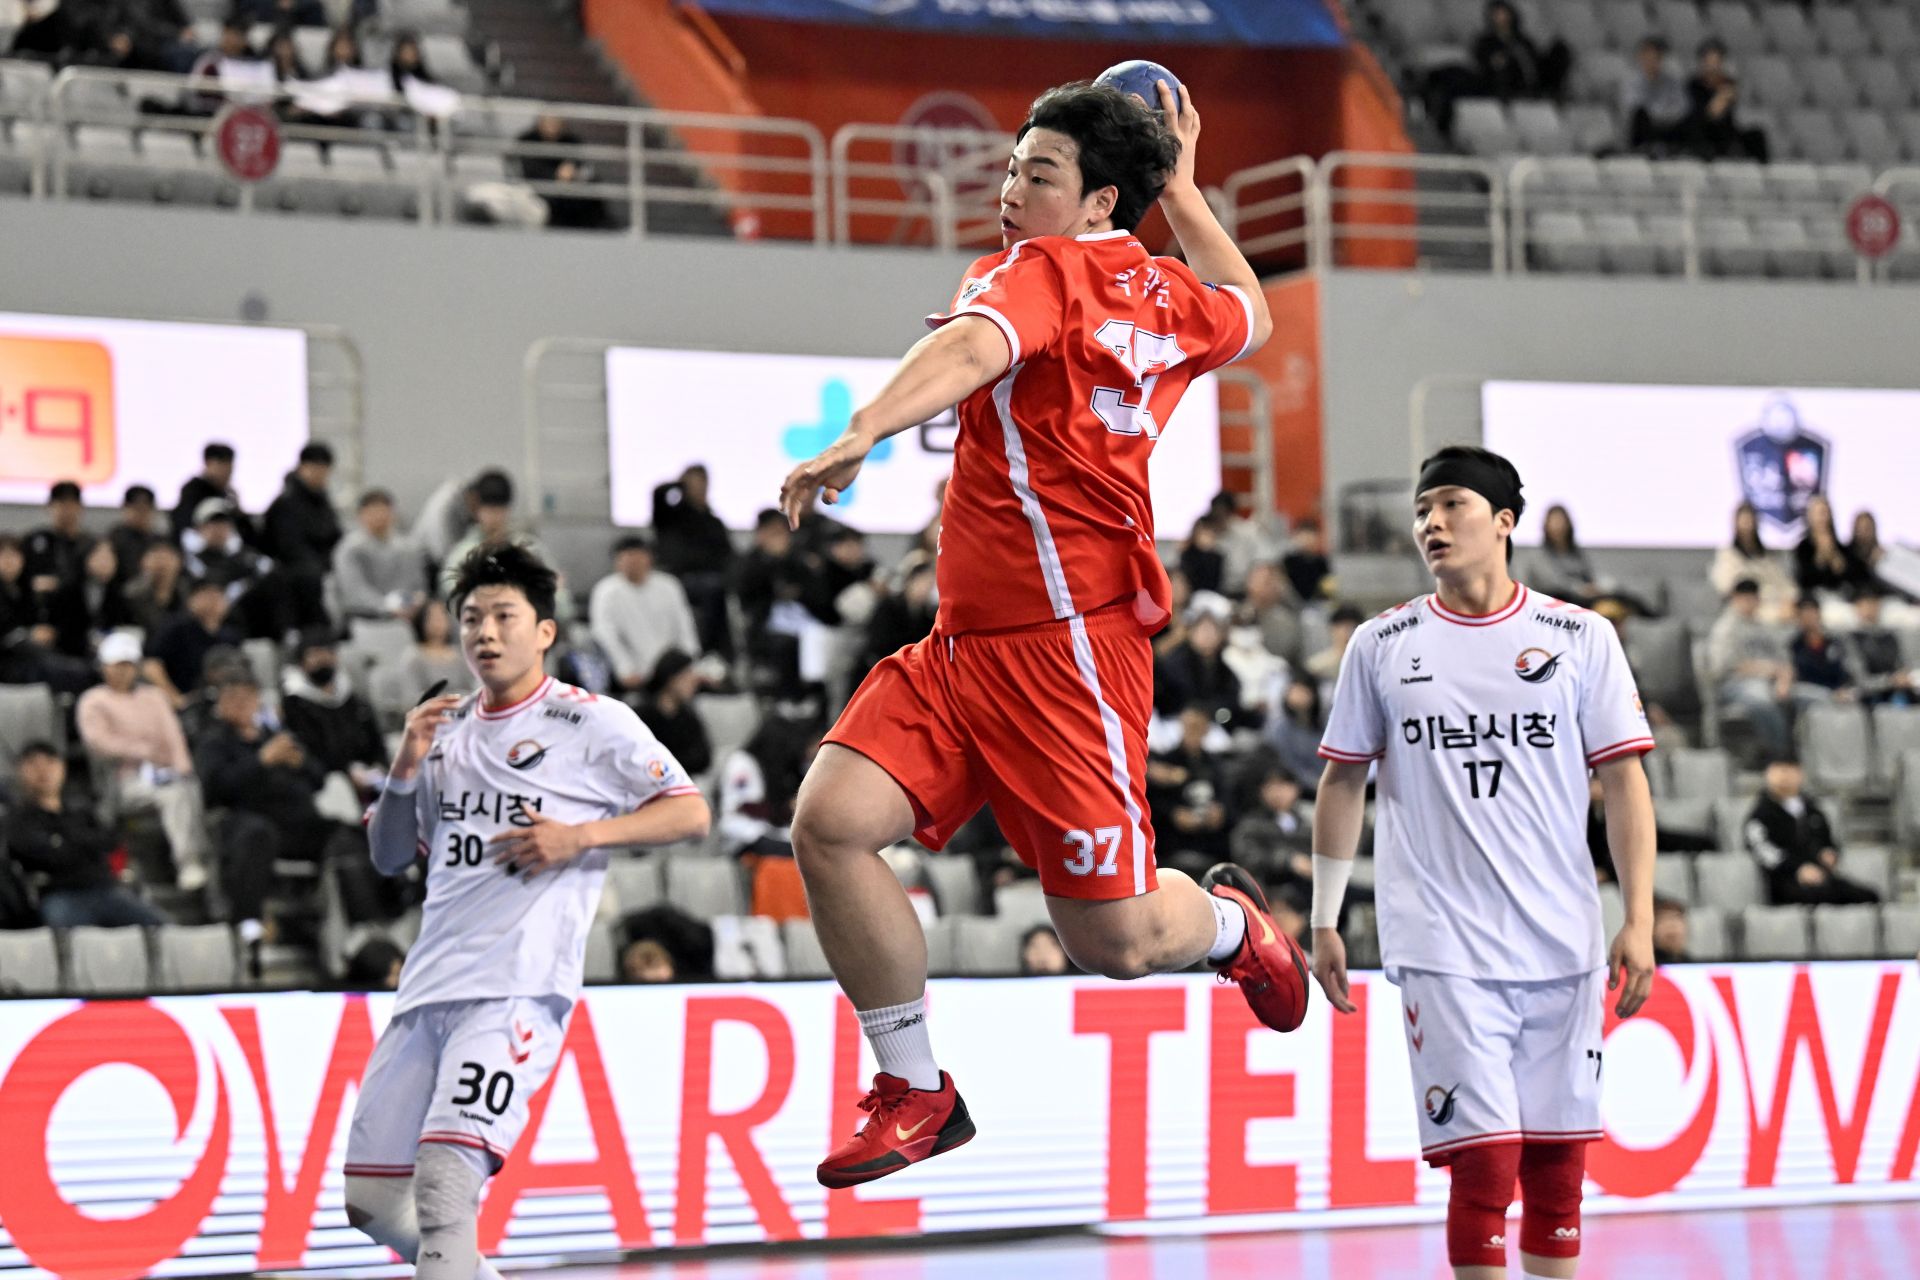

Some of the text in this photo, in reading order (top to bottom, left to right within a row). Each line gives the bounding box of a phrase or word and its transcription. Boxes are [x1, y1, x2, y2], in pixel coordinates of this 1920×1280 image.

[1536, 613, 1582, 632] HANAM
[1402, 712, 1556, 750] 하남시청
[1463, 760, 1503, 799] 17
[439, 791, 542, 827] 남시청
[445, 832, 483, 867] 30
[1063, 825, 1122, 876] 37
[451, 1062, 514, 1116] 30
